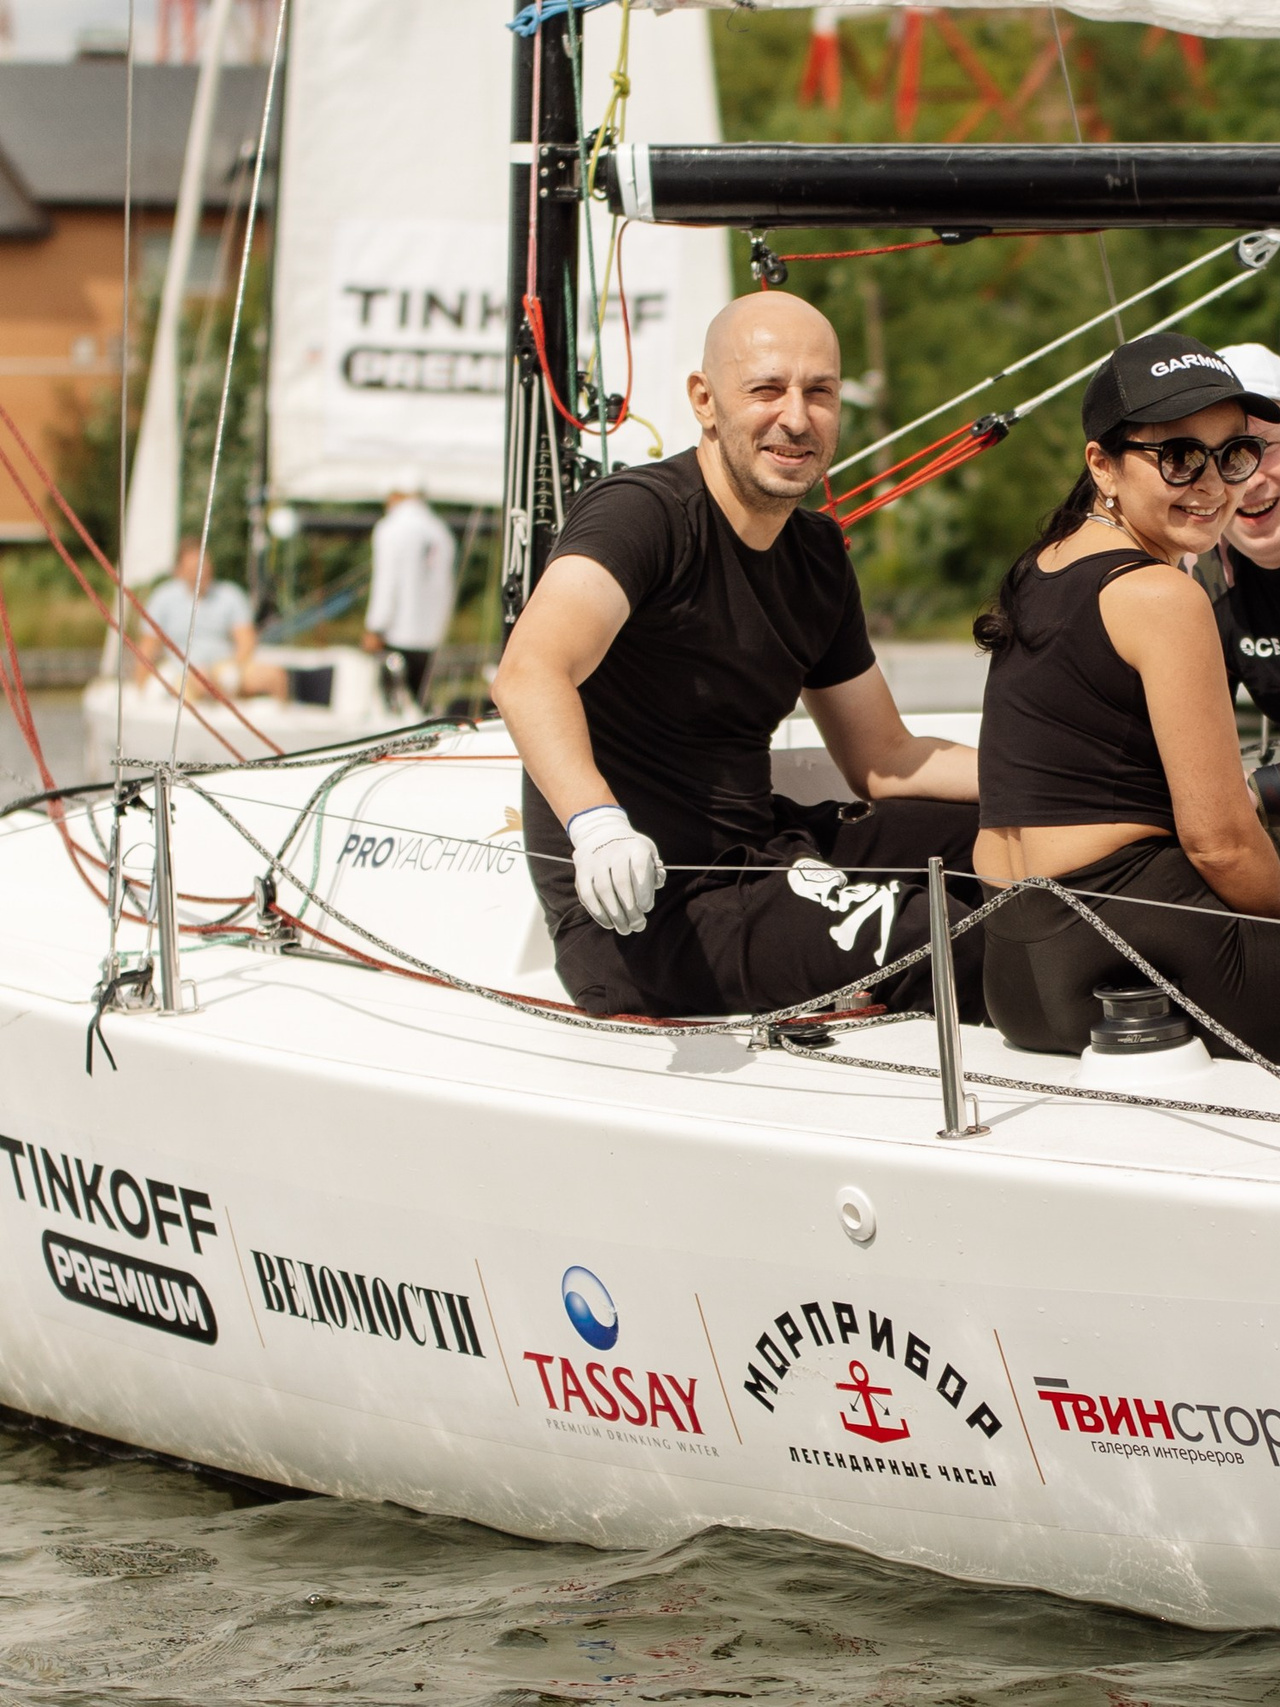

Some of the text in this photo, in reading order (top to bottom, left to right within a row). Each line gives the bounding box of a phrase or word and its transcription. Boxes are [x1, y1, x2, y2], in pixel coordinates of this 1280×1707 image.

[1151, 354, 1234, 379] GARMIN
[0, 1134, 218, 1256] TINKOFF
[48, 1242, 209, 1332] PREMIUM
[250, 1249, 487, 1359] ВЕДОМОСТИ
[523, 1351, 706, 1436] TASSAY
[743, 1301, 1003, 1440] МОРПРИБОР
[545, 1418, 720, 1458] PREMIUM DRINKING WATER
[788, 1446, 997, 1487] ЛЕГЕНДАРНЫЕ ЧАСЫ
[1091, 1440, 1245, 1467] галерея интерьеров
